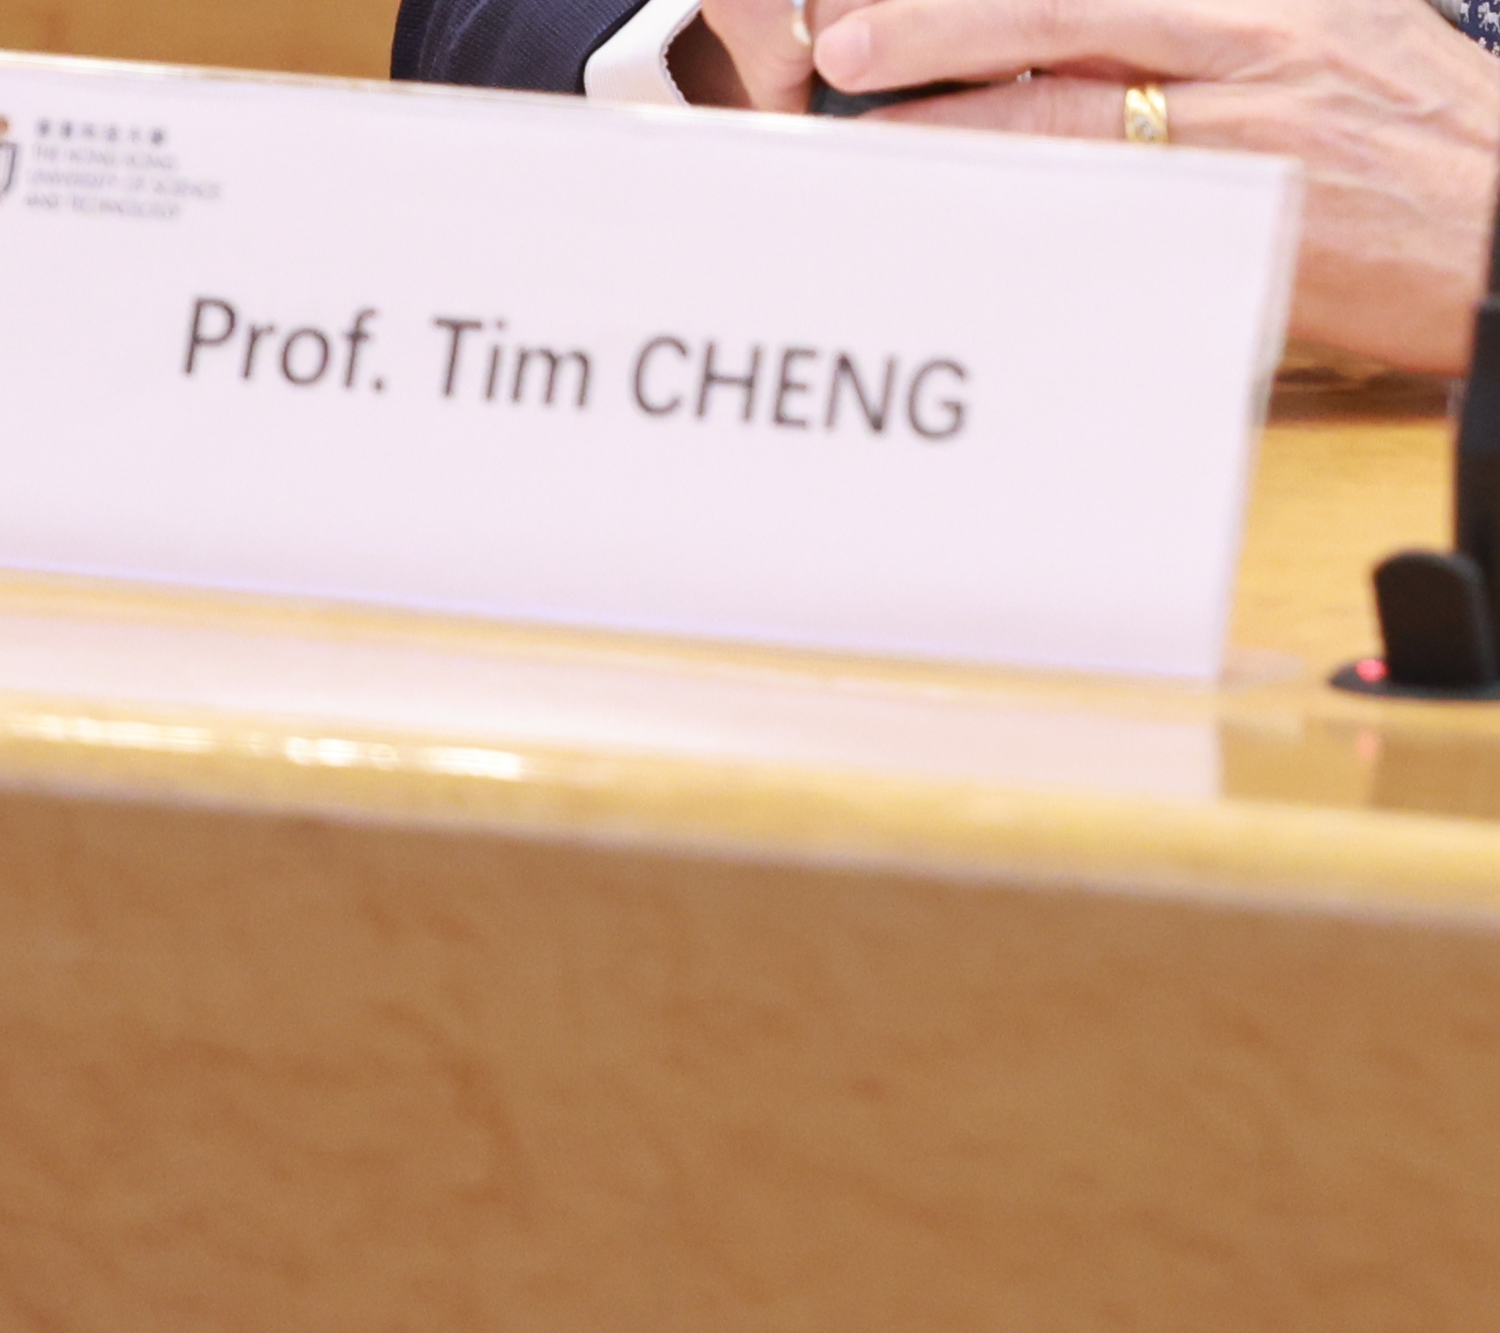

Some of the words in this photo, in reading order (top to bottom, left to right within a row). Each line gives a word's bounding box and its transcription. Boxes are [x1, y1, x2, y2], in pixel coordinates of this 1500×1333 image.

[182, 295, 385, 393] Prof.
[431, 315, 593, 409] Tim
[630, 334, 968, 442] CHENG
